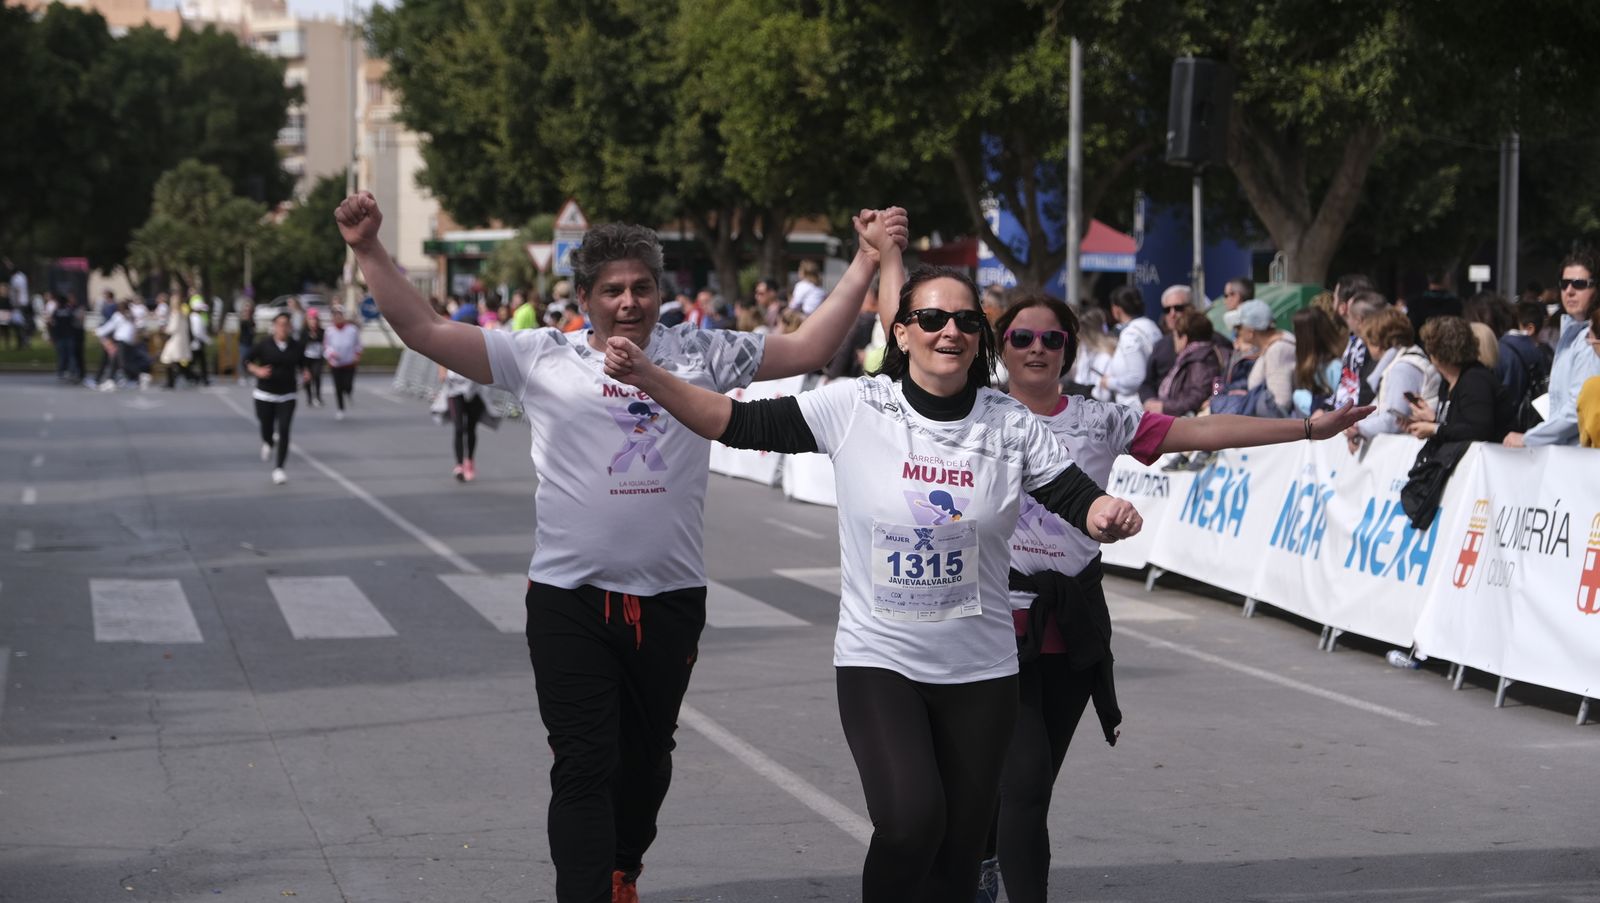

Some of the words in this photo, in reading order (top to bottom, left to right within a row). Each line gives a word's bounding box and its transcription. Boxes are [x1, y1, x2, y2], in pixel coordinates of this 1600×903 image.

[908, 452, 945, 465] CARRERA
[960, 460, 971, 468] LA
[902, 462, 975, 488] MUJER
[885, 535, 910, 543] MUJER
[1022, 546, 1049, 555] NUESTRA
[887, 550, 963, 578] 1315
[889, 576, 962, 586] JAVIEVAALVARLEO
